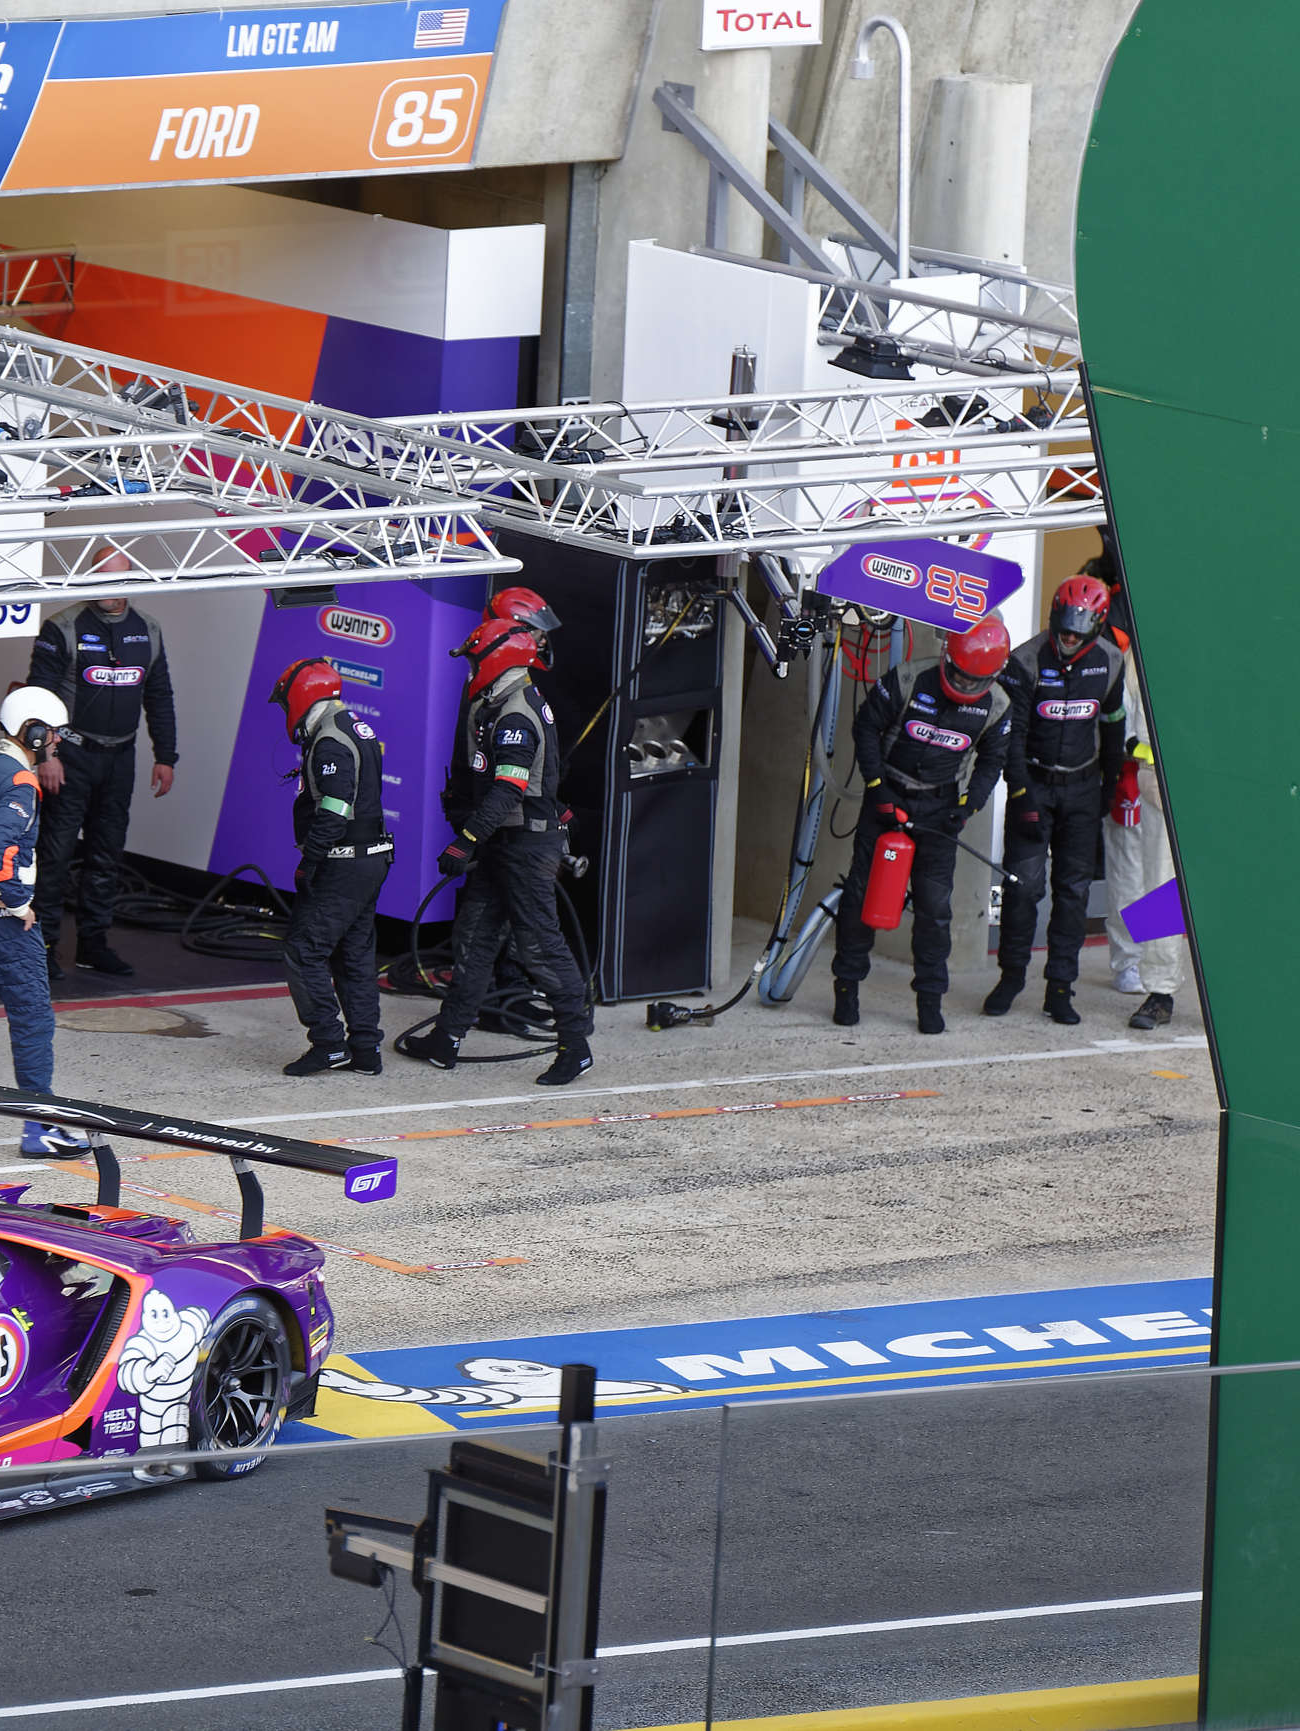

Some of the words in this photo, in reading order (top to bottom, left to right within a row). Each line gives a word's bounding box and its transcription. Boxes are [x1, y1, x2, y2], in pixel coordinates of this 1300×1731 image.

[716, 9, 812, 33] TOTAL
[226, 24, 259, 58] LM
[262, 22, 300, 56] GTE
[302, 20, 340, 54] AM
[149, 103, 261, 161] FORD
[385, 87, 464, 148] 85
[925, 563, 990, 616] 85
[884, 849, 897, 861] 85
[158, 1126, 247, 1150] Powered
[247, 1141, 281, 1156] by
[351, 1170, 394, 1194] GT
[655, 1308, 1213, 1382] MICHE
[103, 1408, 128, 1422] HEEL
[103, 1419, 136, 1435] TREAD
